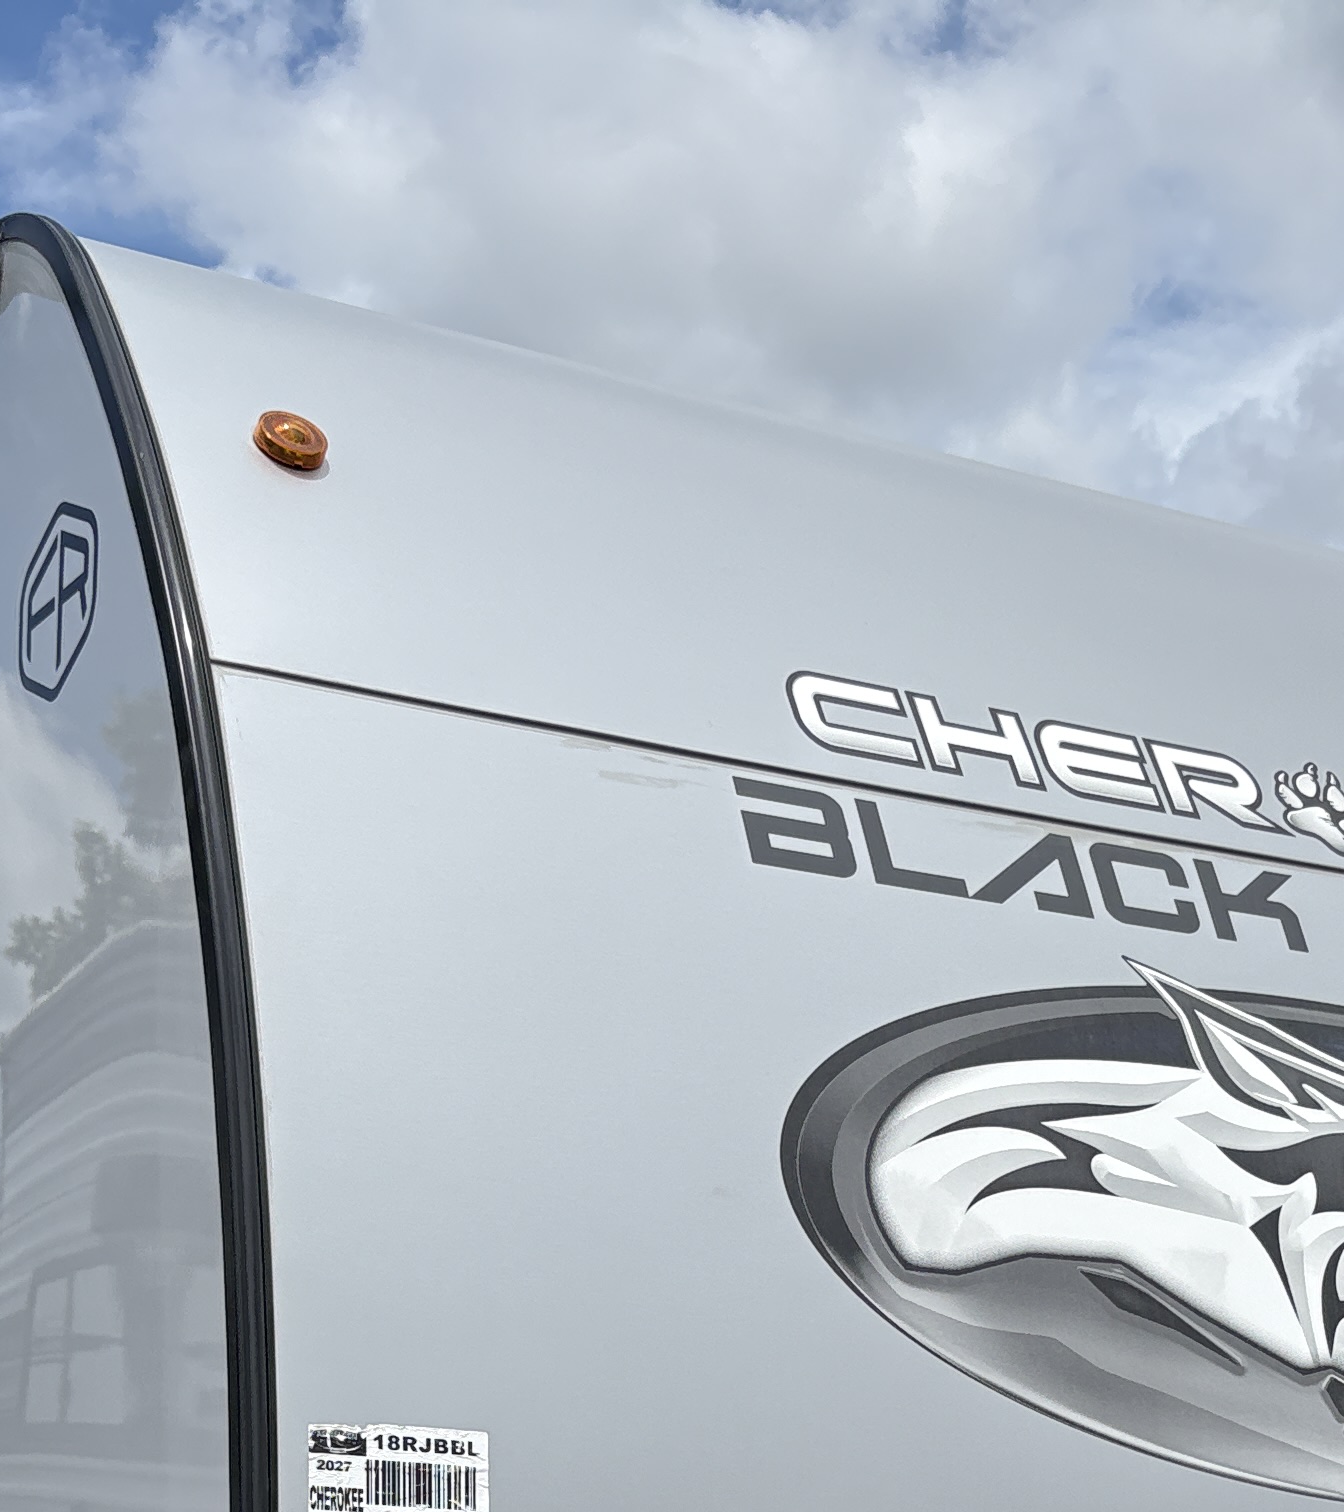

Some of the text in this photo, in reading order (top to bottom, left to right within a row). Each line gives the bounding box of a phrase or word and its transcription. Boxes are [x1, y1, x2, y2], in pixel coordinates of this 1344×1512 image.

[731, 776, 1309, 953] BLACK
[373, 1434, 480, 1456] 18RJBBL
[316, 1459, 353, 1472] 2027
[309, 1485, 364, 1512] CHEROKEE
